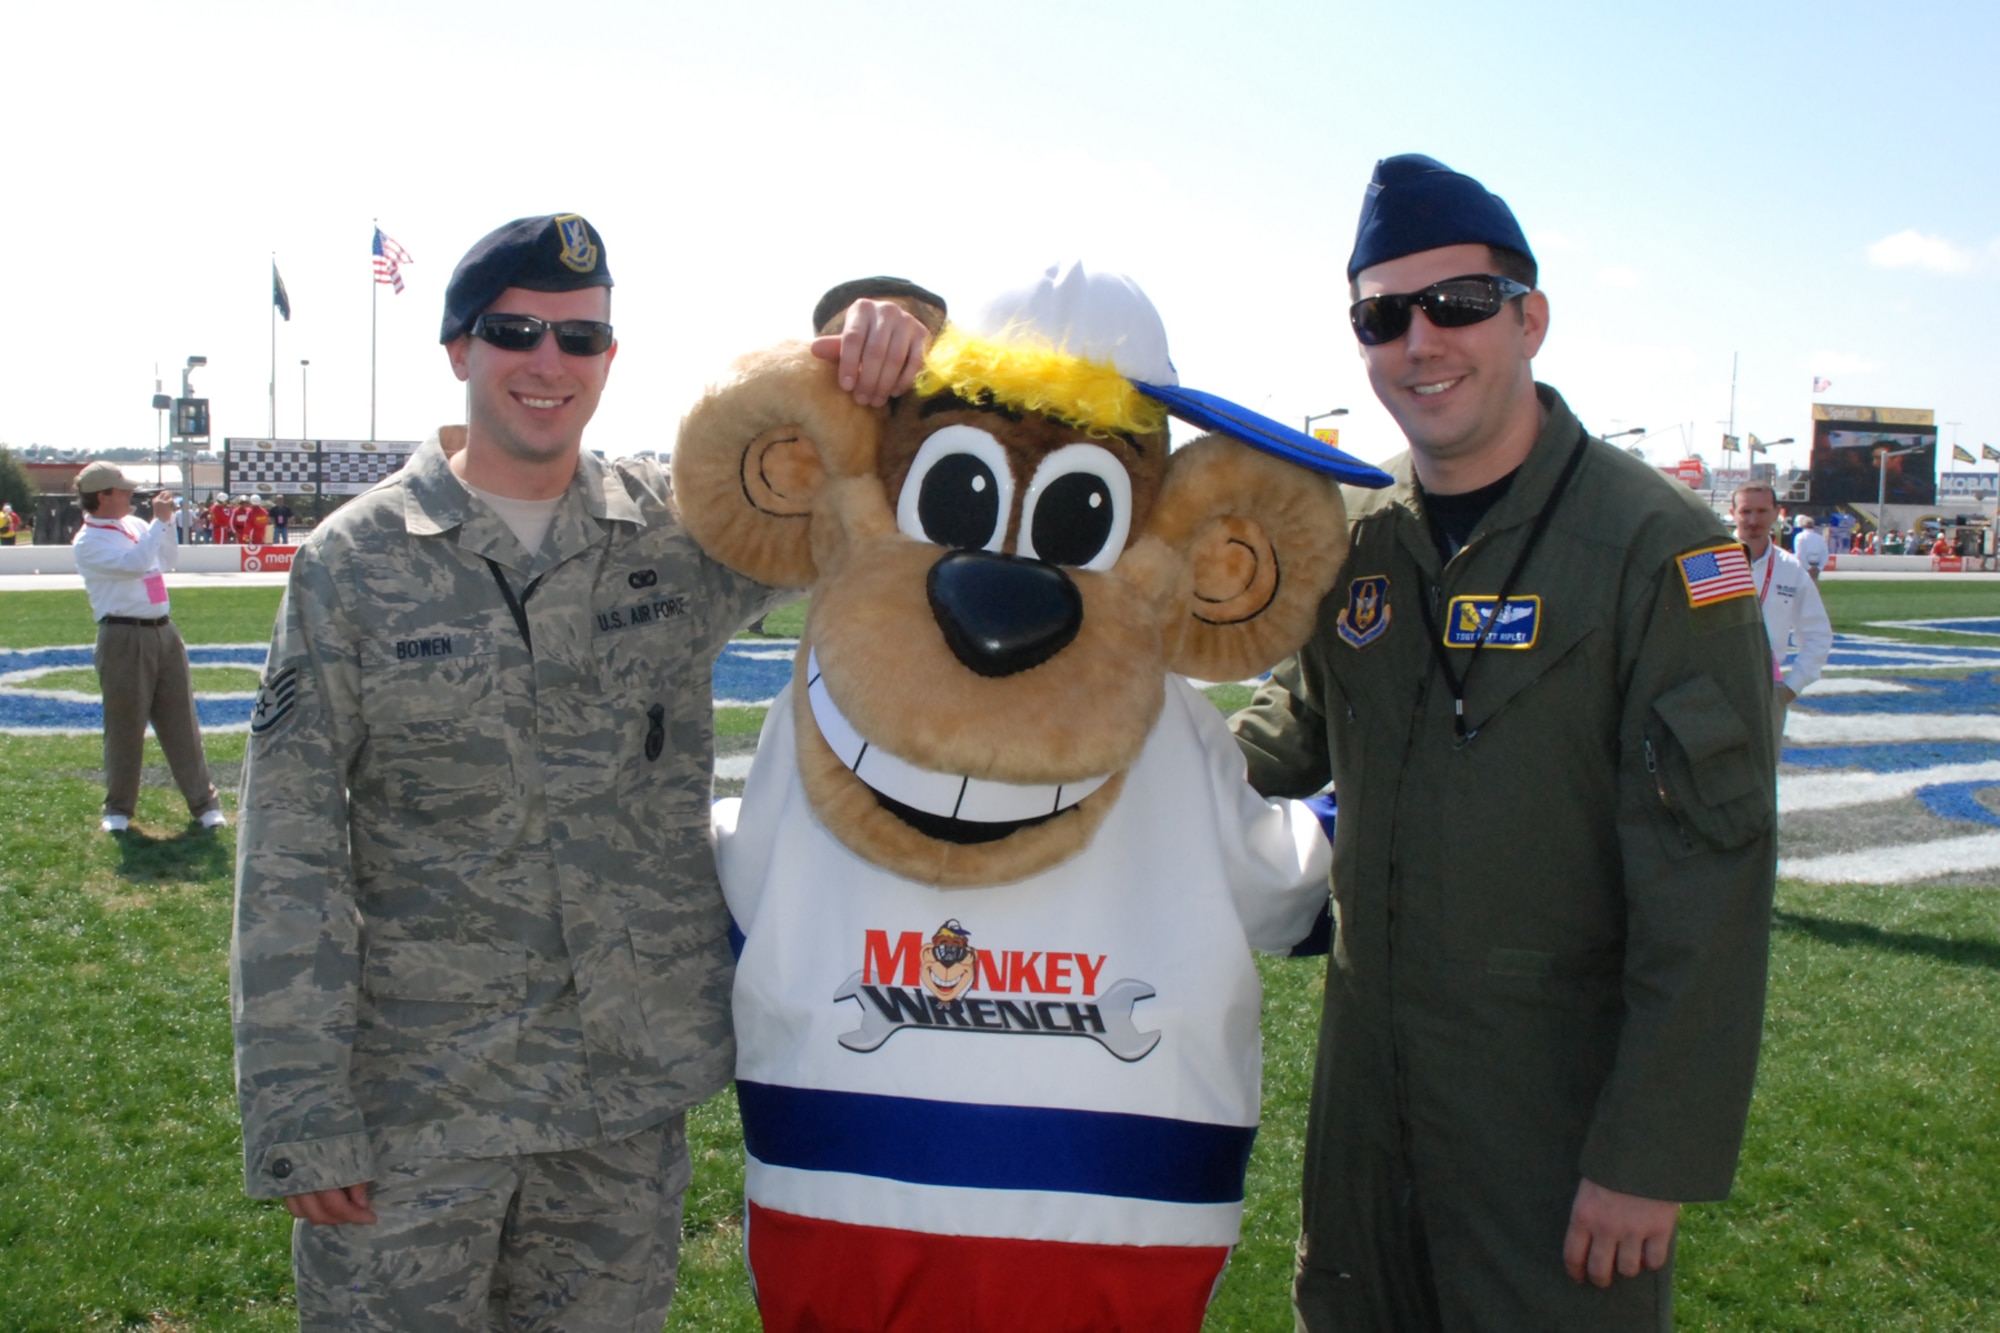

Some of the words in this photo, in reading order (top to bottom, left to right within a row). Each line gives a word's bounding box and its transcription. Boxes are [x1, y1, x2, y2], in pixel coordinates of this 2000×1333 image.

[597, 610, 627, 631] U.S.
[631, 605, 651, 625] AIR
[653, 597, 685, 618] FORCE
[396, 637, 452, 659] BOWEN
[1477, 632, 1498, 641] TT
[863, 928, 1107, 996] MNKEY
[861, 985, 1106, 1033] WRENCH
